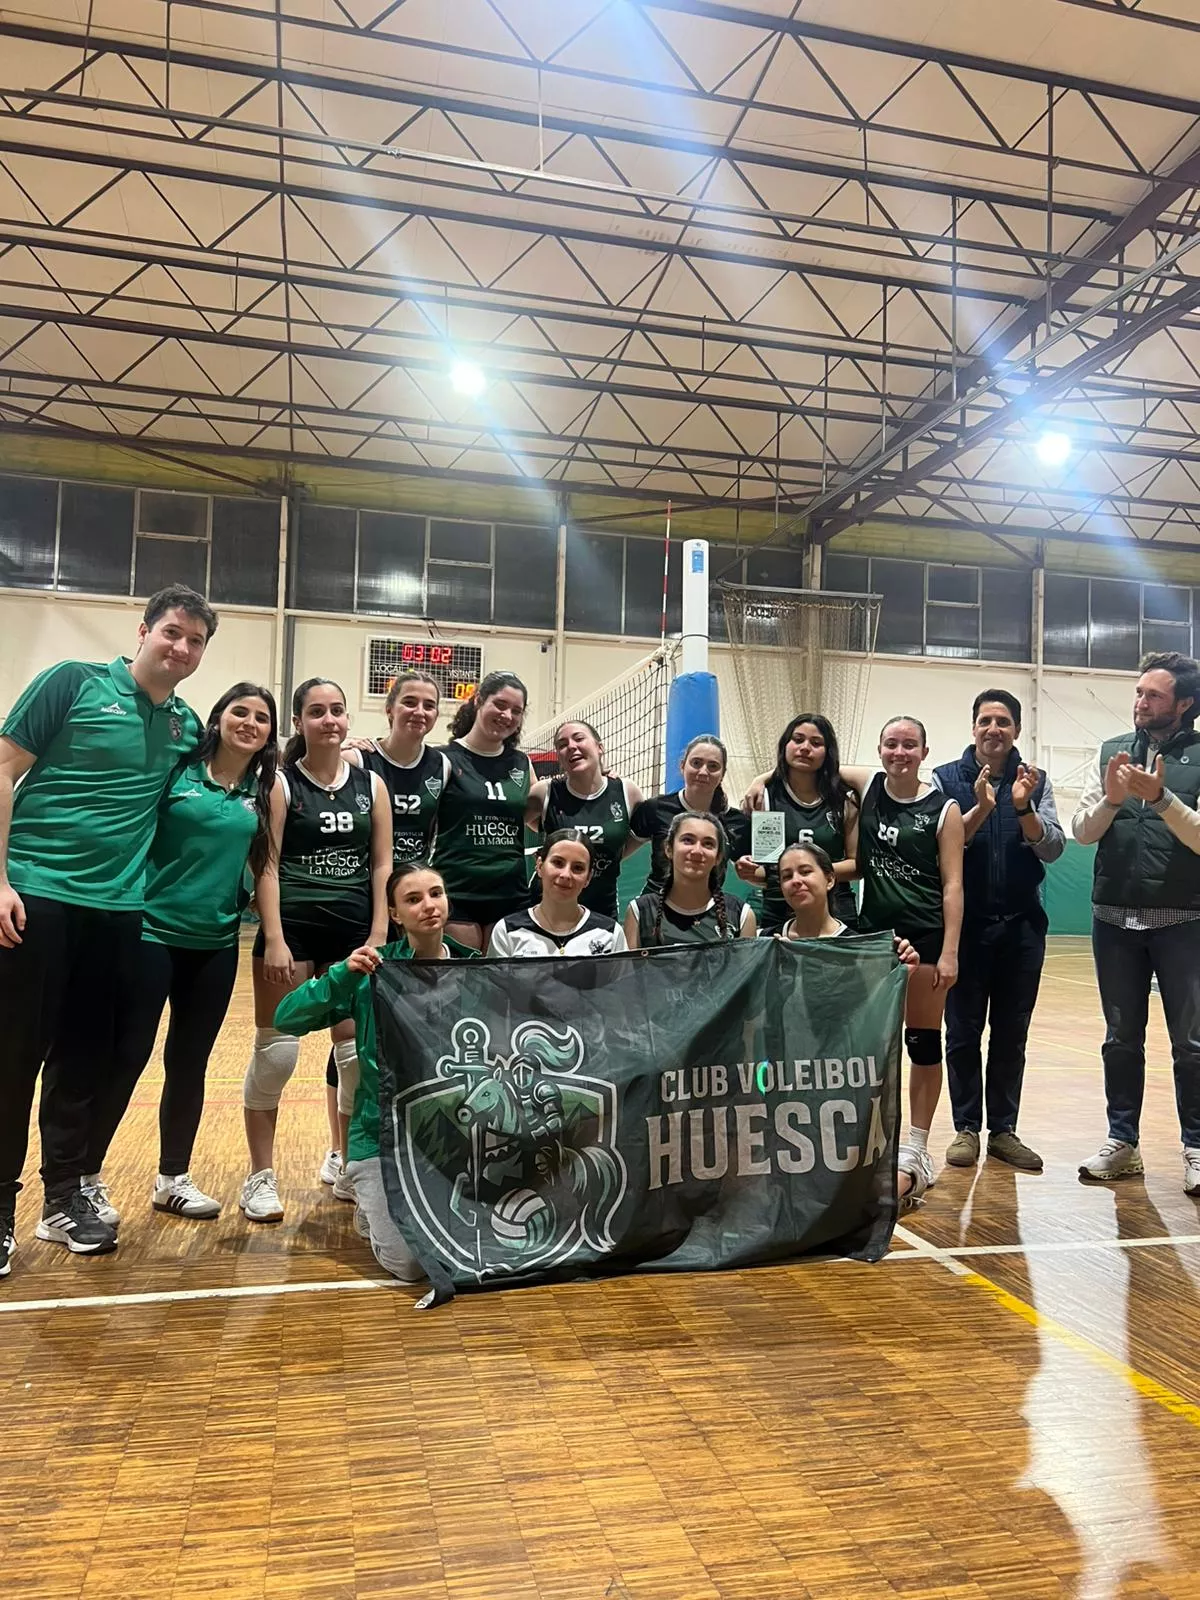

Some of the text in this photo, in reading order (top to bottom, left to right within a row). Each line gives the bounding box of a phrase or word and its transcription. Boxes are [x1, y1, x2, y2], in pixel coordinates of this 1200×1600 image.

[448, 669, 477, 680] VISITANTE
[484, 781, 507, 801] 11
[394, 794, 421, 815] 52
[319, 811, 353, 833] 38
[661, 1055, 884, 1102] CLUB VOLEIBOL
[645, 1094, 888, 1191] HUESCA
